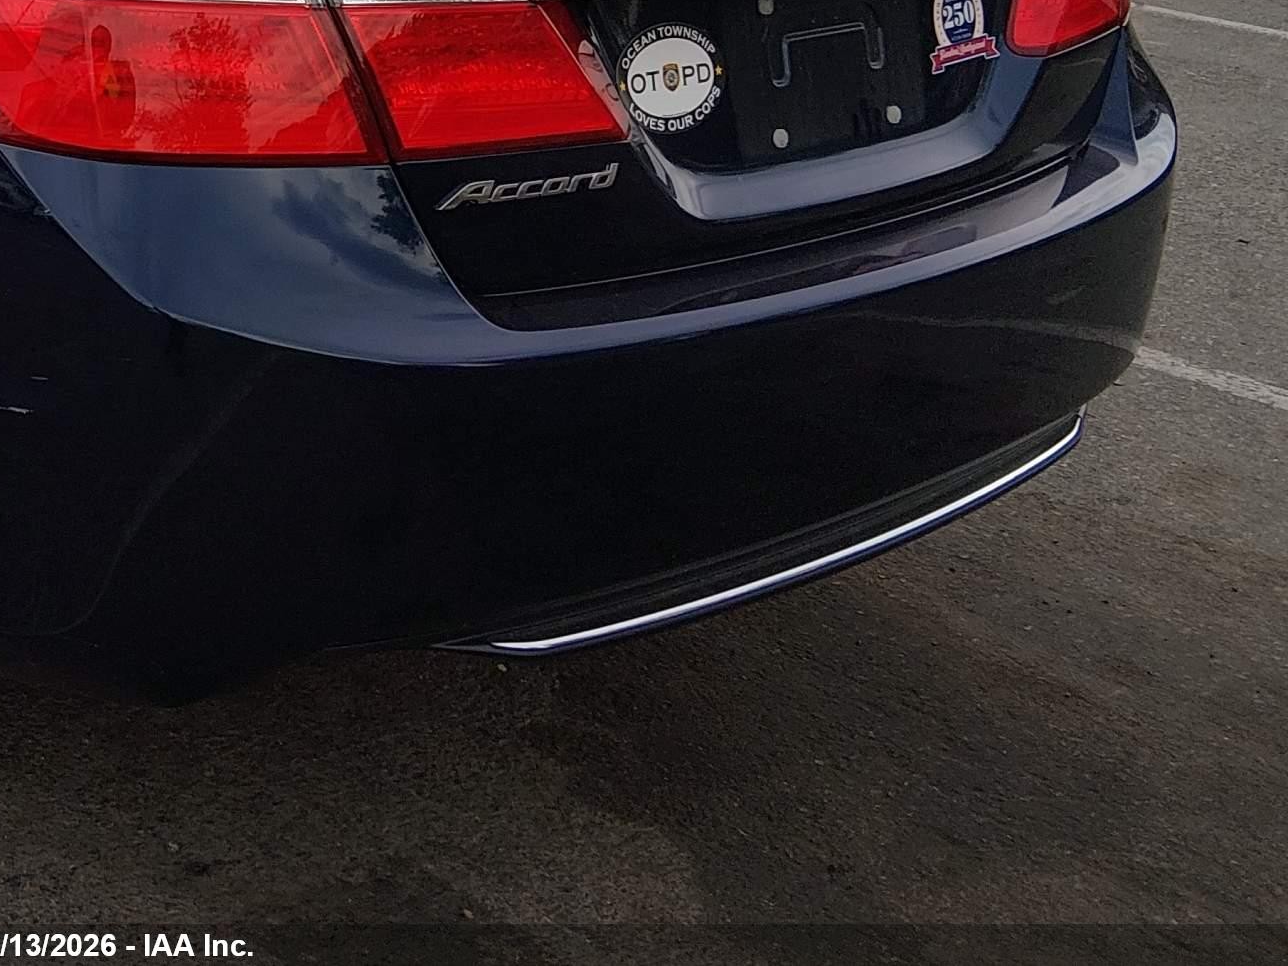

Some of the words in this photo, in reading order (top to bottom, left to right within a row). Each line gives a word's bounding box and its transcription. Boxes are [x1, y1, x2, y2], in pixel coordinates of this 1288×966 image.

[943, 0, 975, 30] 250
[622, 30, 657, 69] OCEAN
[658, 25, 716, 54] TOWNSHIP
[631, 70, 660, 94] OT
[682, 63, 711, 86] PD
[630, 103, 665, 131] LOVES
[668, 116, 694, 131] OUR
[695, 85, 721, 120] COPS
[434, 162, 619, 211] Accord
